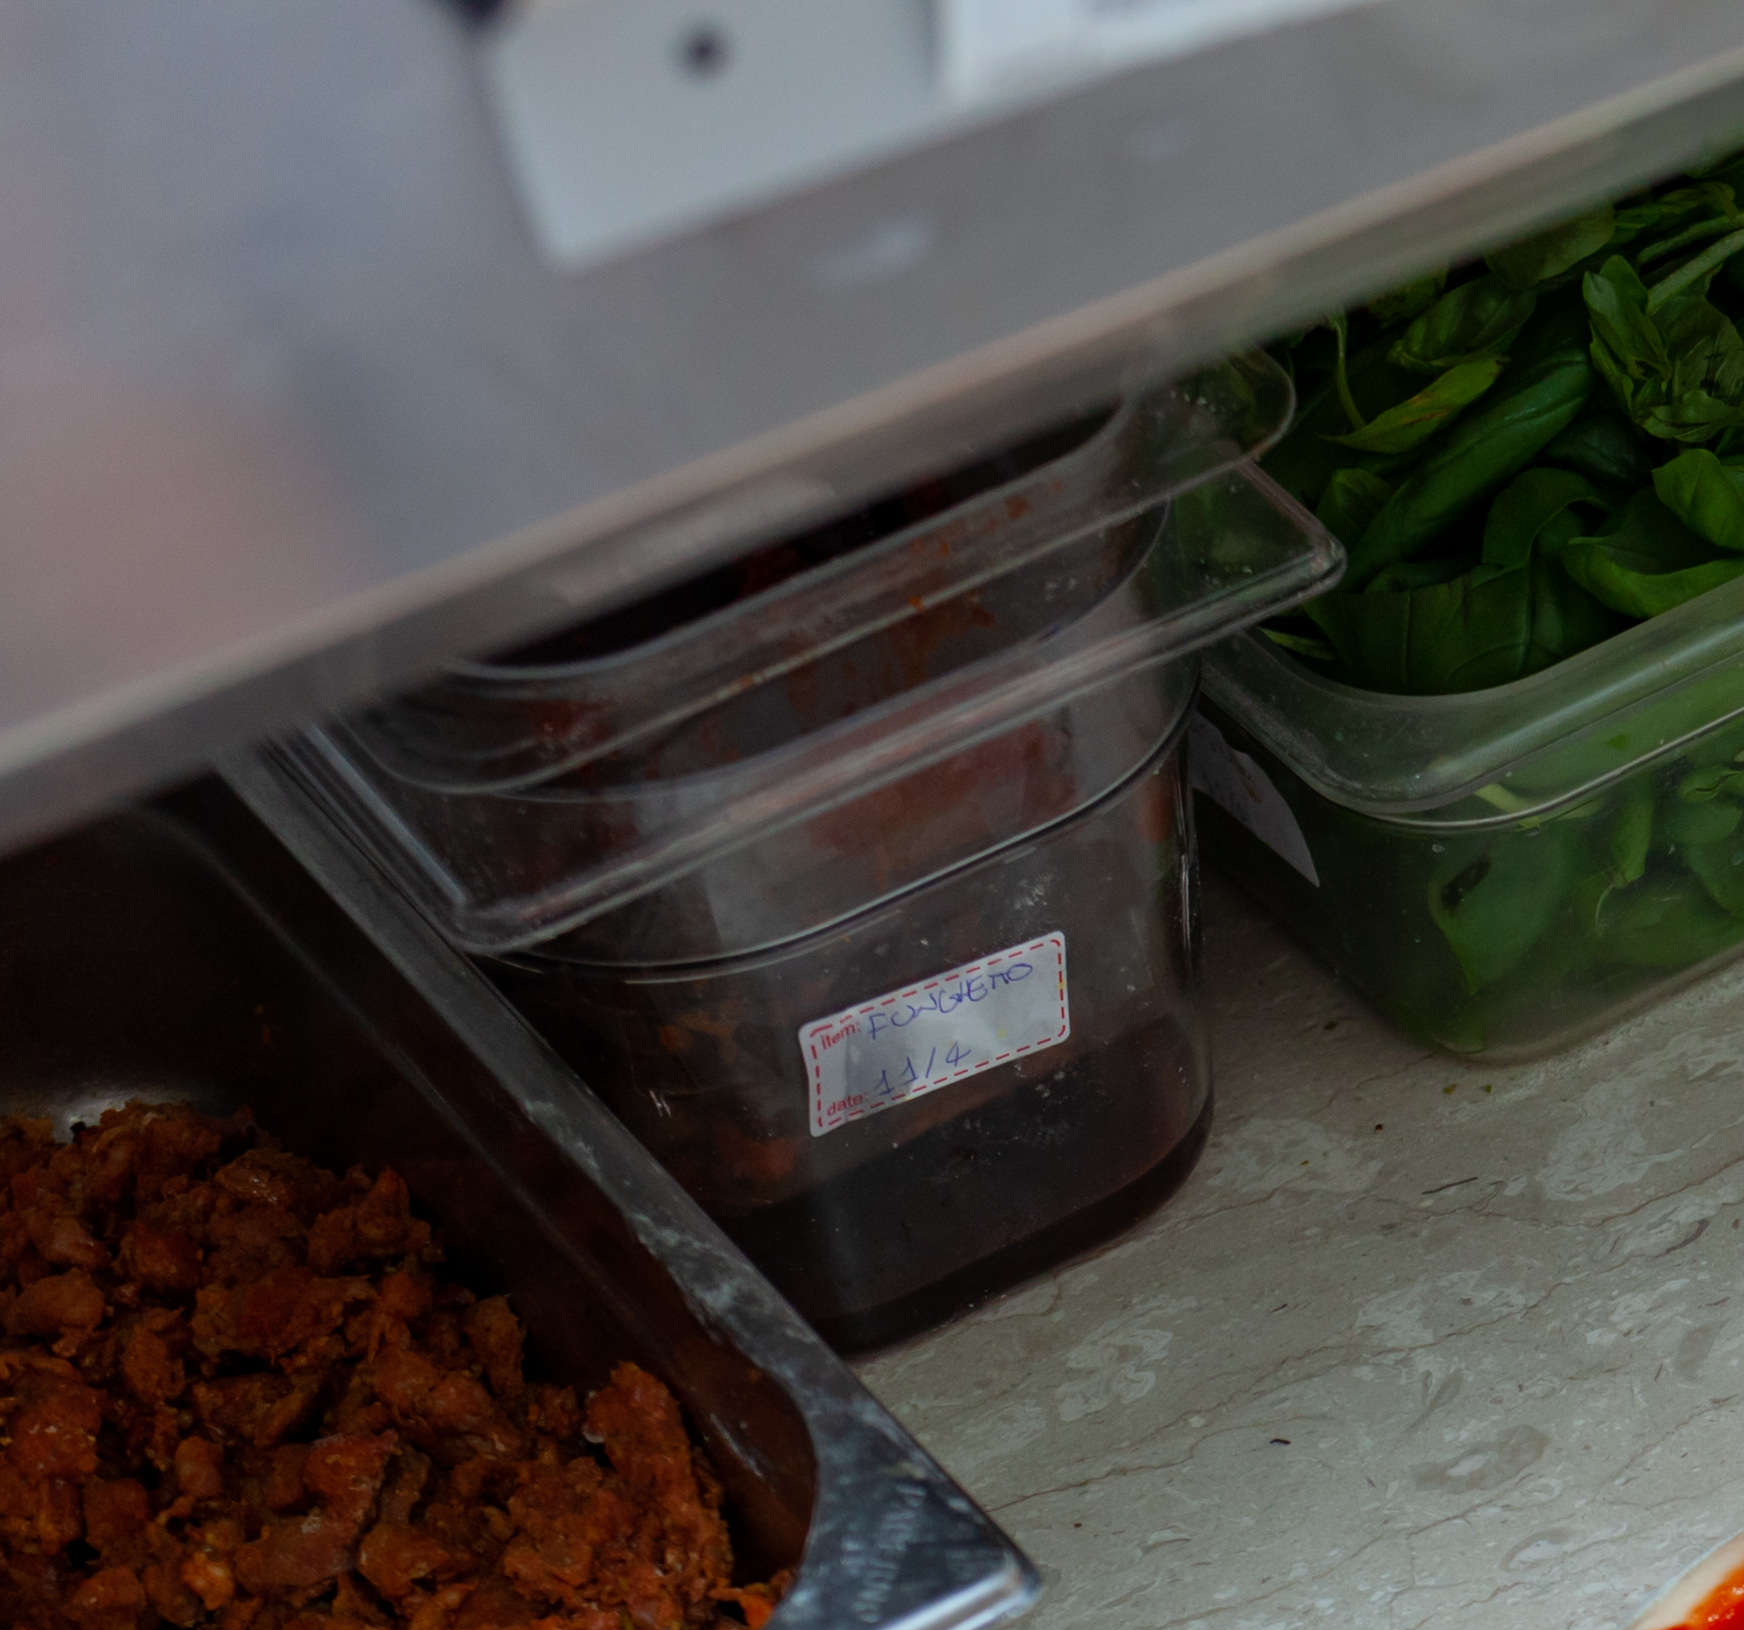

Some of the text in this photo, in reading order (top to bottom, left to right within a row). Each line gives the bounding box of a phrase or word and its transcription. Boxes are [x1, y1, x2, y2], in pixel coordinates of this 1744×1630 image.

[821, 1022, 861, 1050] item:
[826, 1041, 972, 1117] date: 11/4
